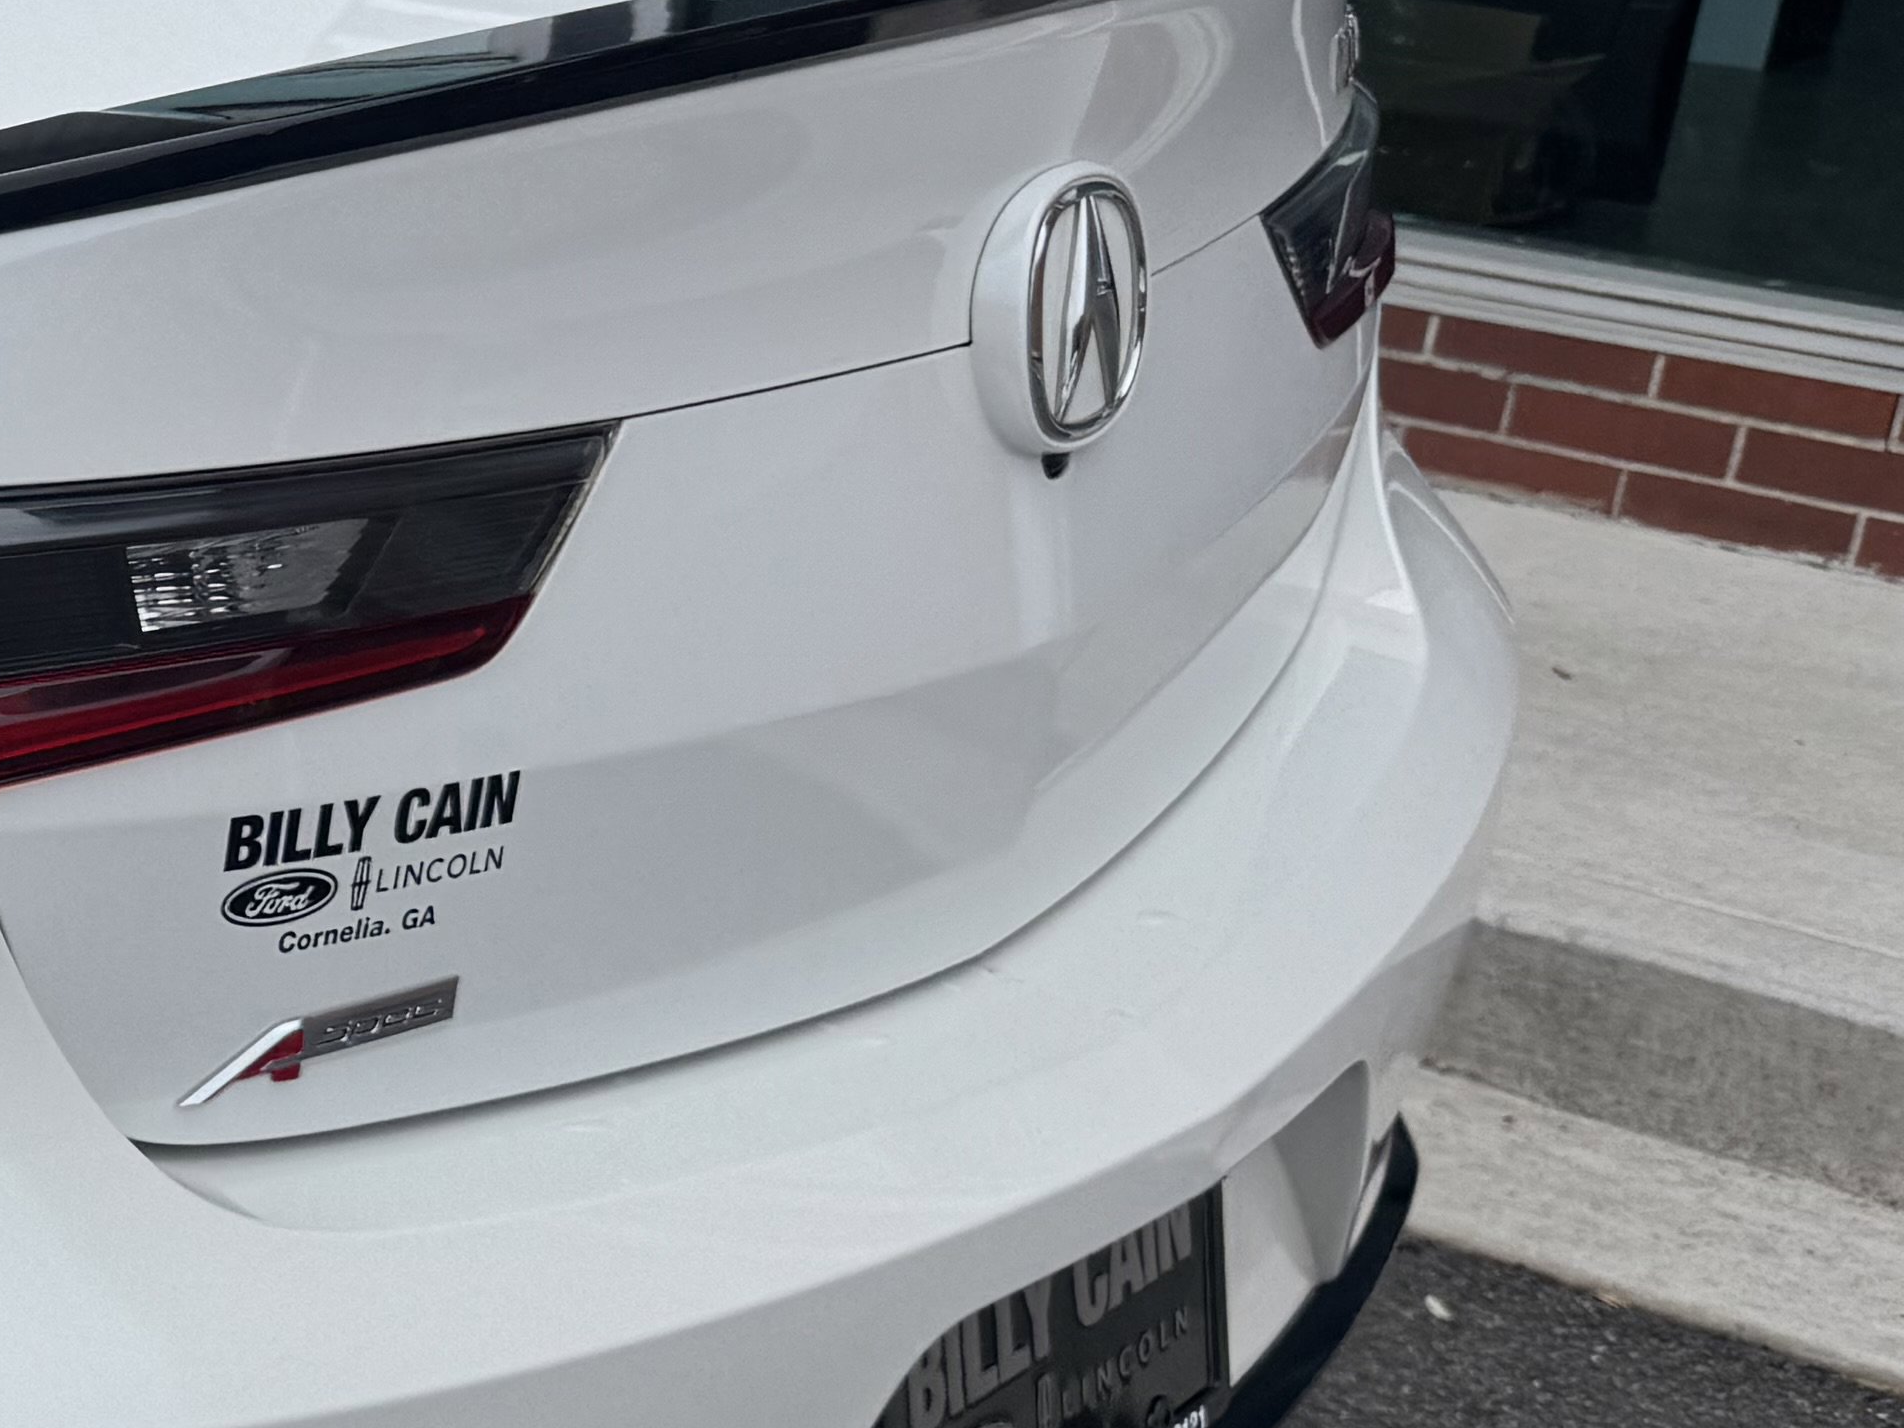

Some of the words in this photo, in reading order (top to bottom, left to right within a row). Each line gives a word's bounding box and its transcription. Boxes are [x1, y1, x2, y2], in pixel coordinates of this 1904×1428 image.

[223, 795, 382, 872] BILLY
[394, 770, 521, 845] CAIN
[243, 880, 317, 919] Ford
[376, 846, 504, 893] LINCOLN
[401, 905, 436, 931] GA
[1072, 1204, 1193, 1327] CAIN
[1061, 1305, 1190, 1420] LINCOLN
